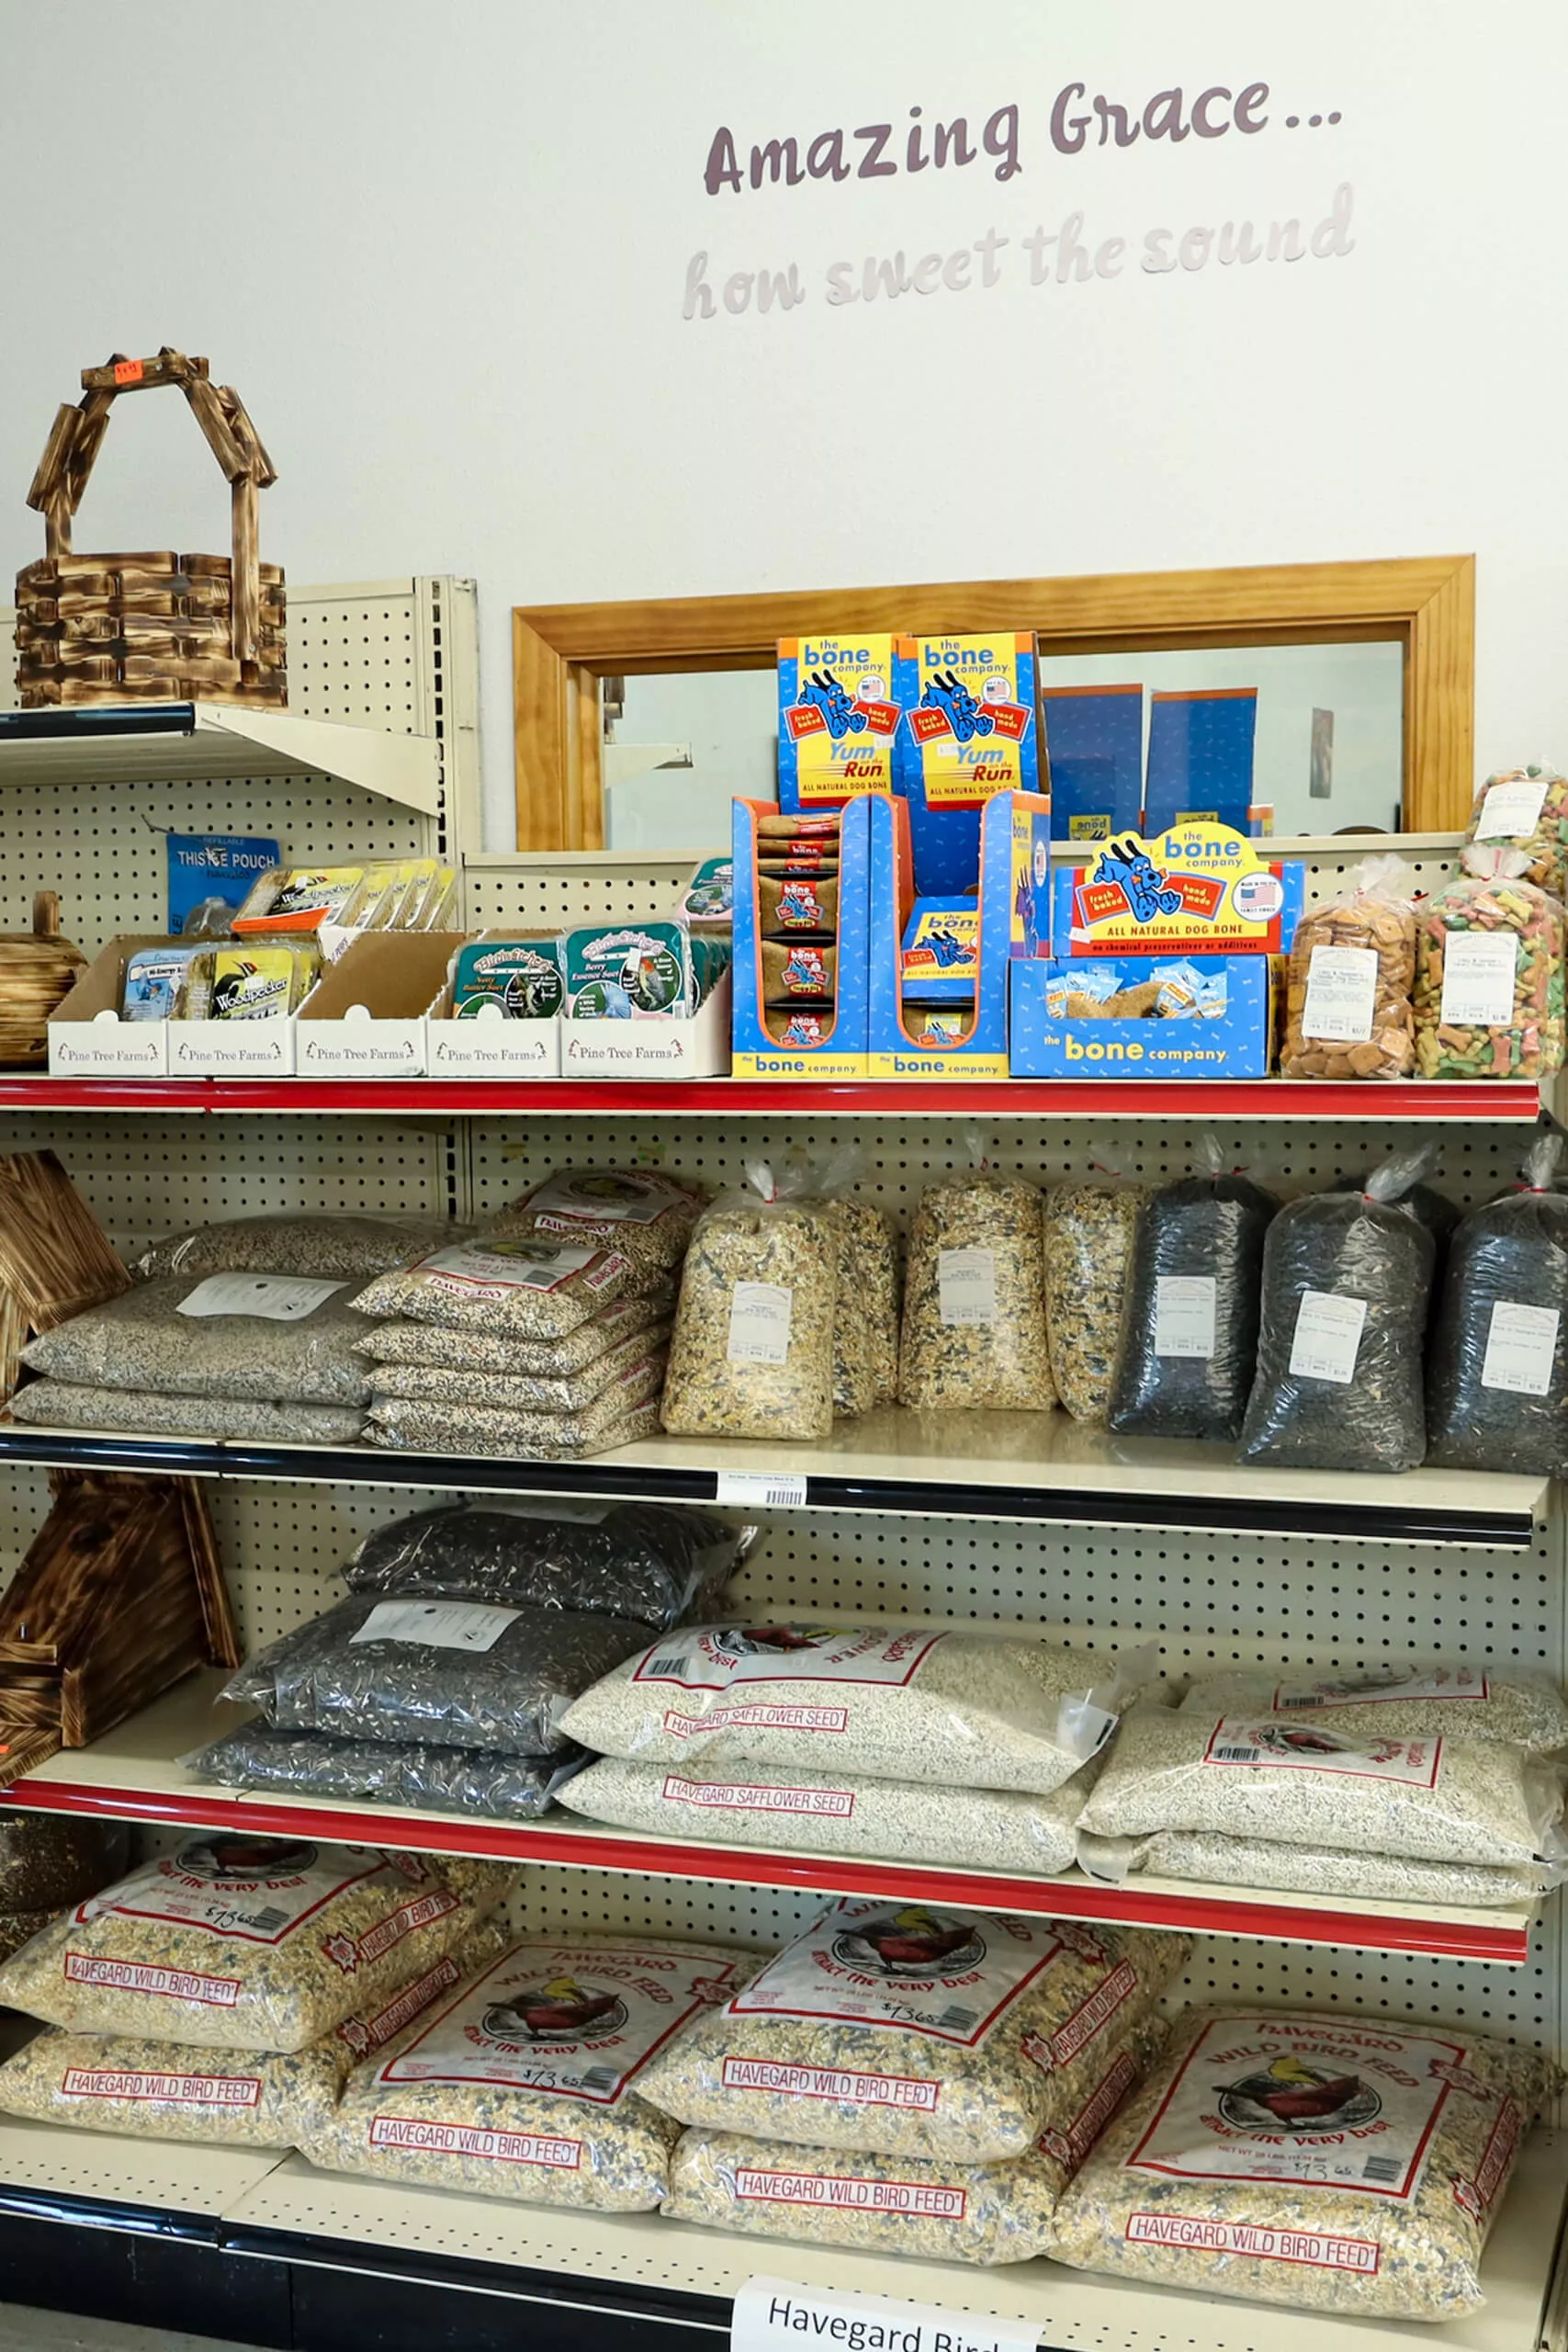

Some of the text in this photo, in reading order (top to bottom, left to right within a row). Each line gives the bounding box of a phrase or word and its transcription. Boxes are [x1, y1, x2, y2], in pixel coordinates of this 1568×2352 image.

[704, 103, 1022, 195] Amazing
[682, 182, 1357, 321] how sweet the sound
[820, 639, 838, 650] the
[941, 639, 960, 650] the
[805, 645, 870, 665] bone
[925, 645, 994, 667] bone
[829, 741, 875, 761] Yum
[957, 745, 1004, 764] Yum
[844, 761, 883, 778] Run
[972, 764, 1012, 782] Run
[803, 781, 887, 791] ALL NATURAL DOG BONE
[931, 787, 942, 796] ALL
[944, 786, 976, 795] NATURAL
[1183, 831, 1203, 842] the
[1165, 836, 1241, 859] bone
[231, 853, 276, 869] POUCH
[1089, 891, 1114, 904] fresh
[1183, 883, 1208, 897] hand
[1093, 896, 1123, 911] baked
[1186, 894, 1211, 906] made
[928, 917, 978, 928] bon
[1107, 924, 1244, 936] ALL NATURAL DOG BONE
[1105, 942, 1143, 951] chemical
[1144, 942, 1203, 953] preservatives
[1218, 941, 1258, 950] additives
[215, 978, 288, 1012] Woodpecker
[68, 1050, 149, 1061] Pine Tree Farms
[189, 1050, 272, 1061] Pine Tree Farms
[317, 1047, 404, 1060] Pine Tree Farms
[448, 1049, 536, 1061] Pine Tree Farms
[580, 1046, 672, 1059] Pine Tree Farms
[1043, 1035, 1060, 1046] the
[1066, 1035, 1145, 1060] bone
[756, 1057, 805, 1071] bone
[895, 1057, 944, 1072] bone
[671, 1779, 734, 1804] HAVEGARD
[736, 1786, 810, 1810] SAFFLOWER
[574, 1964, 631, 1979] BIRD
[135, 1967, 165, 1989] WILD
[168, 1975, 200, 1996] BIRD
[1205, 2041, 1420, 2088] WILD BIRD FEED
[71, 2072, 142, 2096] HAVEGARD
[145, 2075, 179, 2098] WILD
[183, 2078, 214, 2098] BIRD
[731, 2061, 810, 2092] HAVEGARD
[814, 2069, 852, 2097] WILD
[855, 2075, 890, 2101] BIRD
[378, 2119, 456, 2147] HAVEGARD
[458, 2125, 494, 2151] WILD
[498, 2130, 532, 2155] BIRD
[743, 2174, 825, 2203] HAVEGARD
[829, 2180, 870, 2206] WILD
[874, 2184, 910, 2210] BIRD
[1135, 2217, 1227, 2248] HAVEGARD
[1233, 2225, 1275, 2255] WILD
[1280, 2233, 1321, 2260] BIRD
[769, 2297, 998, 2352] Havegard Bi
